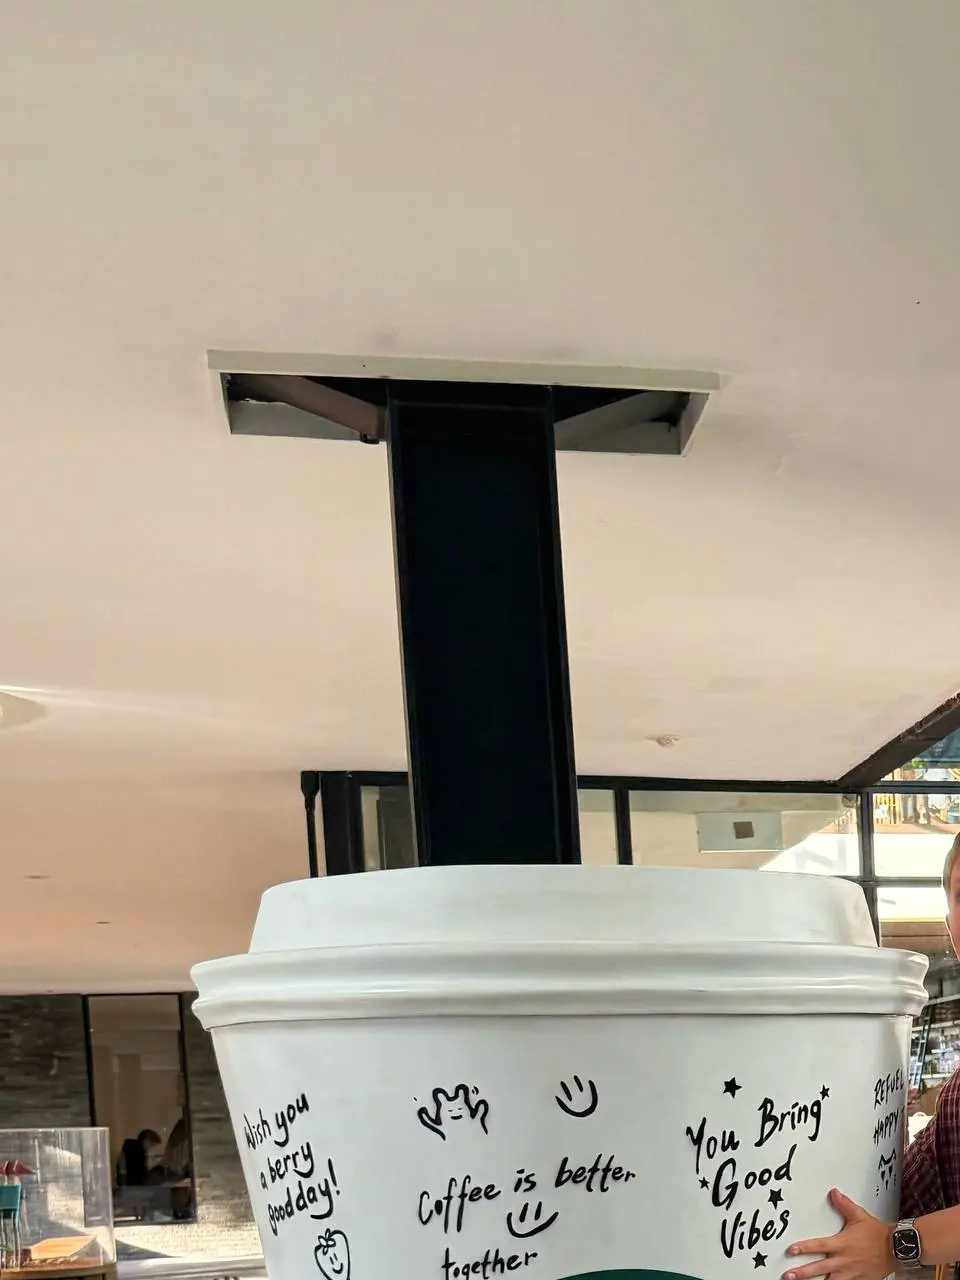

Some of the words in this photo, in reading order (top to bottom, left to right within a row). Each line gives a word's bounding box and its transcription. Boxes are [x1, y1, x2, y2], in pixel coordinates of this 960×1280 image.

[873, 1068, 905, 1110] REFUEL
[243, 1108, 272, 1150] Wish
[273, 1093, 310, 1147] you
[685, 1117, 740, 1175] You
[754, 1097, 823, 1147] Bring
[873, 1108, 899, 1146] HAPPY
[260, 1171, 269, 1190] a
[267, 1142, 315, 1184] berry
[711, 1144, 798, 1210] Good
[418, 1174, 502, 1233] Coffee
[513, 1168, 537, 1193] is
[554, 1154, 636, 1194] better
[720, 1209, 790, 1258] Vibes
